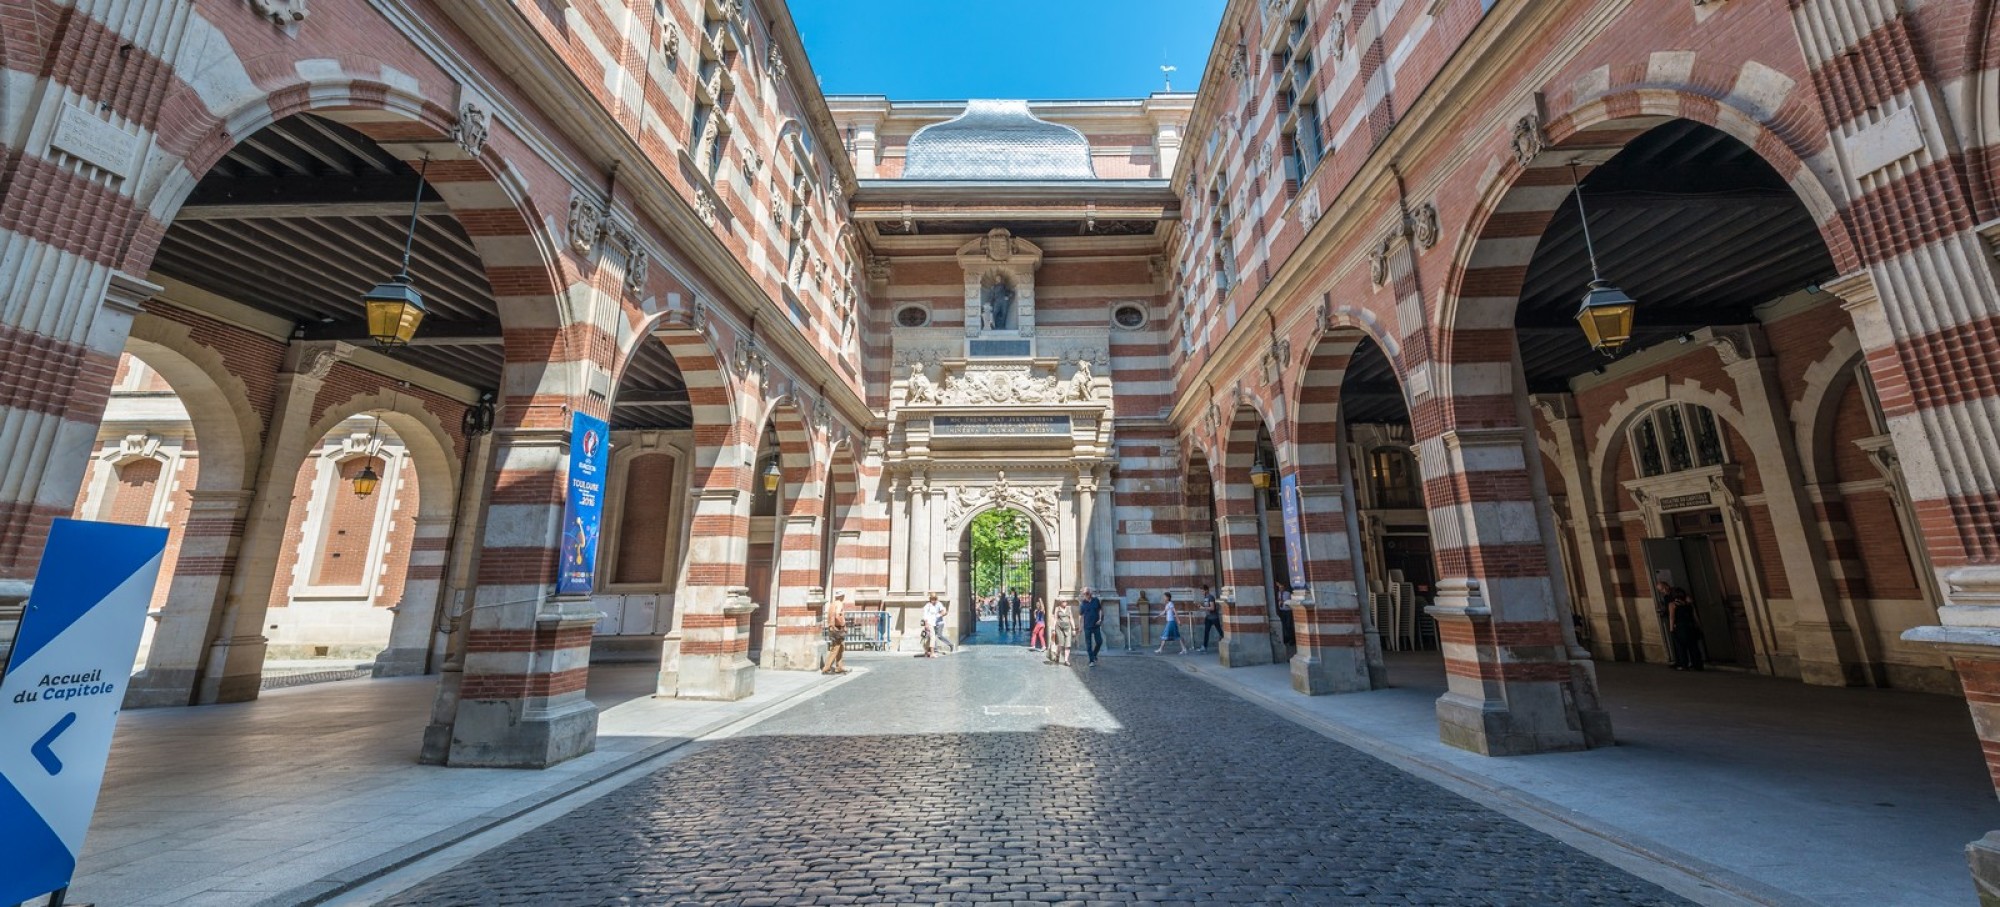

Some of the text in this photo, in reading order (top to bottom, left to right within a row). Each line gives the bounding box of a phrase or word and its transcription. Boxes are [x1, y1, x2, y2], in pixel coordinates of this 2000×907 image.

[573, 478, 599, 491] TOULOUSE
[38, 669, 101, 687] Accueil
[13, 682, 114, 703] du Capitole
